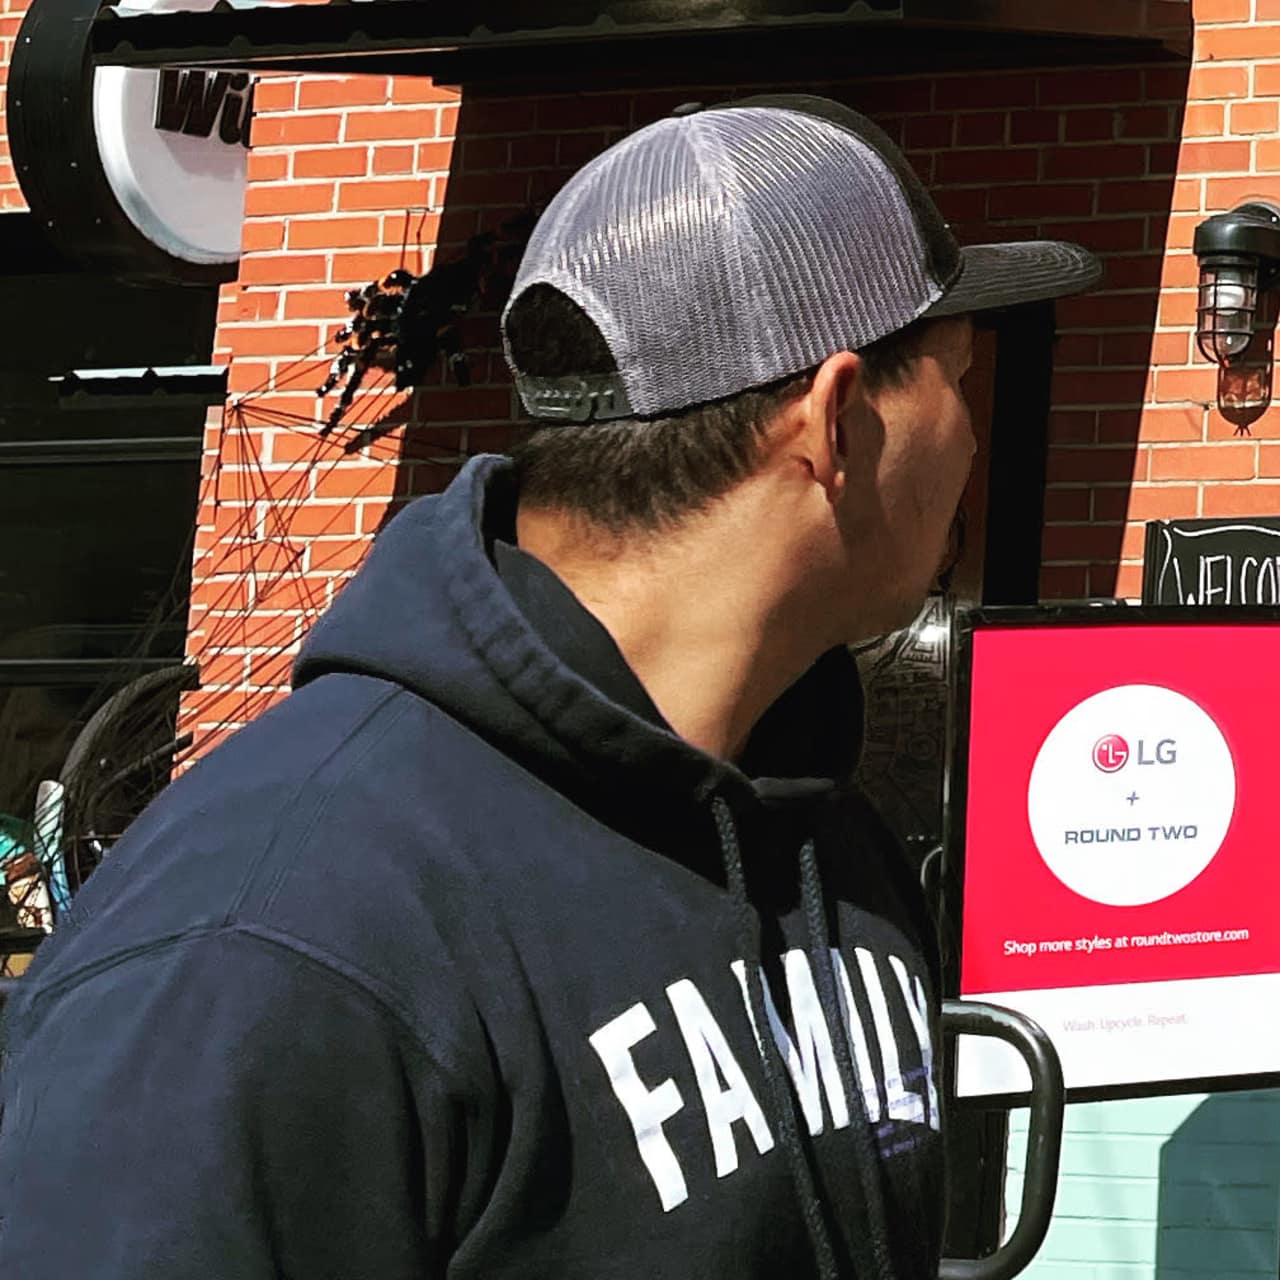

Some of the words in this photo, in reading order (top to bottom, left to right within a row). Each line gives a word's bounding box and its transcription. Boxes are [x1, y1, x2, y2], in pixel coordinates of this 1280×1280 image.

[1138, 738, 1177, 765] LG
[1065, 827, 1141, 845] ROUND
[1147, 825, 1198, 840] TWO
[1004, 940, 1036, 956] Shop
[1040, 941, 1072, 952] more
[1075, 935, 1112, 953] styles
[1114, 936, 1129, 948] at
[1131, 928, 1249, 947] roundtwostore.com
[589, 946, 941, 1213] FAMILY
